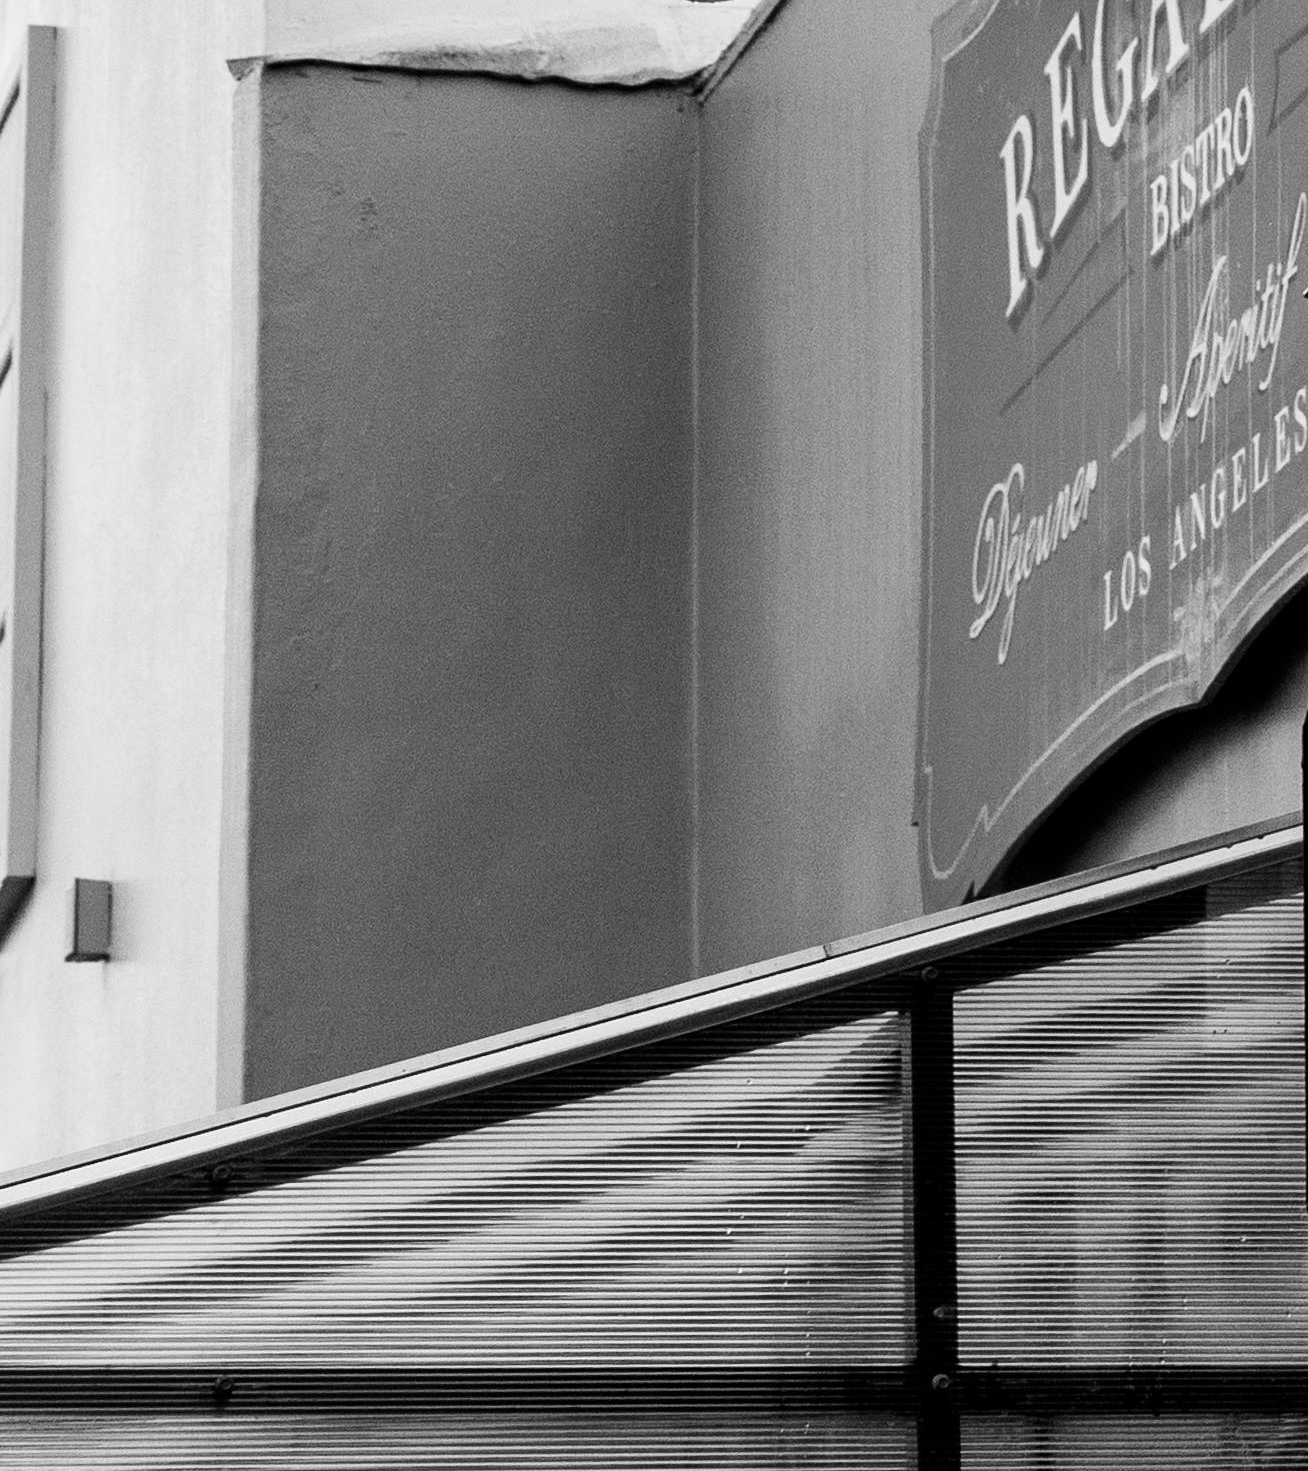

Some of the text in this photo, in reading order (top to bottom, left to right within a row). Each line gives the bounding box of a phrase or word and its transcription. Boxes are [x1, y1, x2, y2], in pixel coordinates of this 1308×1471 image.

[1150, 86, 1254, 257] BISTRO
[1104, 388, 1308, 631] LOS ANGELES
